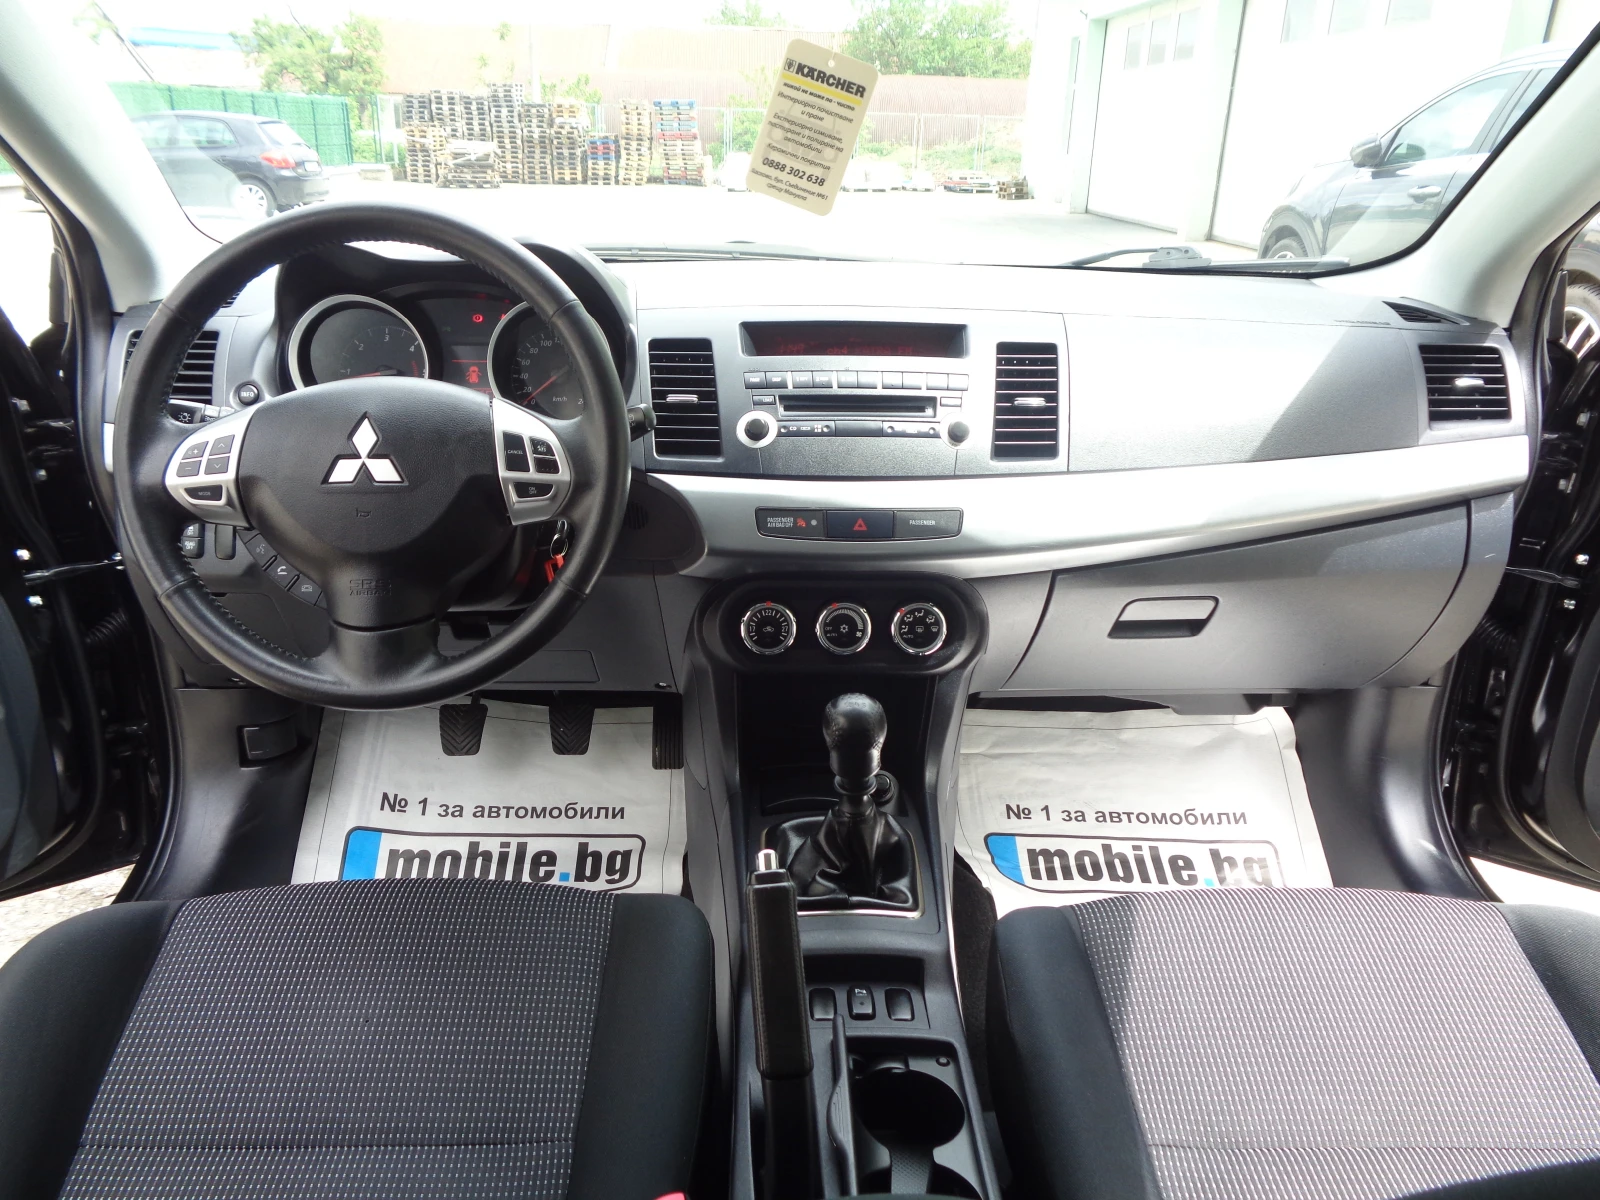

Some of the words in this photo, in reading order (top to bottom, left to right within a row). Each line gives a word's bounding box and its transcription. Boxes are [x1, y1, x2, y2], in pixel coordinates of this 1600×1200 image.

[795, 62, 867, 99] KÄRCHER
[777, 91, 816, 110] Интериорно
[816, 106, 854, 124] почистване
[805, 111, 825, 122] пране
[773, 112, 814, 132] Екстериорно
[783, 136, 823, 154] автомобили
[806, 135, 836, 150] полиране
[762, 157, 787, 173] 0888
[786, 166, 806, 180] 302
[806, 174, 826, 187] 638
[800, 156, 831, 171] покрития
[358, 343, 364, 351] 2
[383, 334, 390, 342] 3
[380, 791, 408, 813] №
[418, 797, 428, 816] 1
[437, 803, 464, 818] за
[472, 802, 626, 820] автомобили
[1006, 803, 1032, 820] №
[1040, 805, 1050, 821] 1
[1061, 809, 1086, 823] за
[1094, 808, 1248, 826] автомобили
[384, 841, 633, 885] mobile.bg
[1026, 843, 1275, 888] mobile.bg
